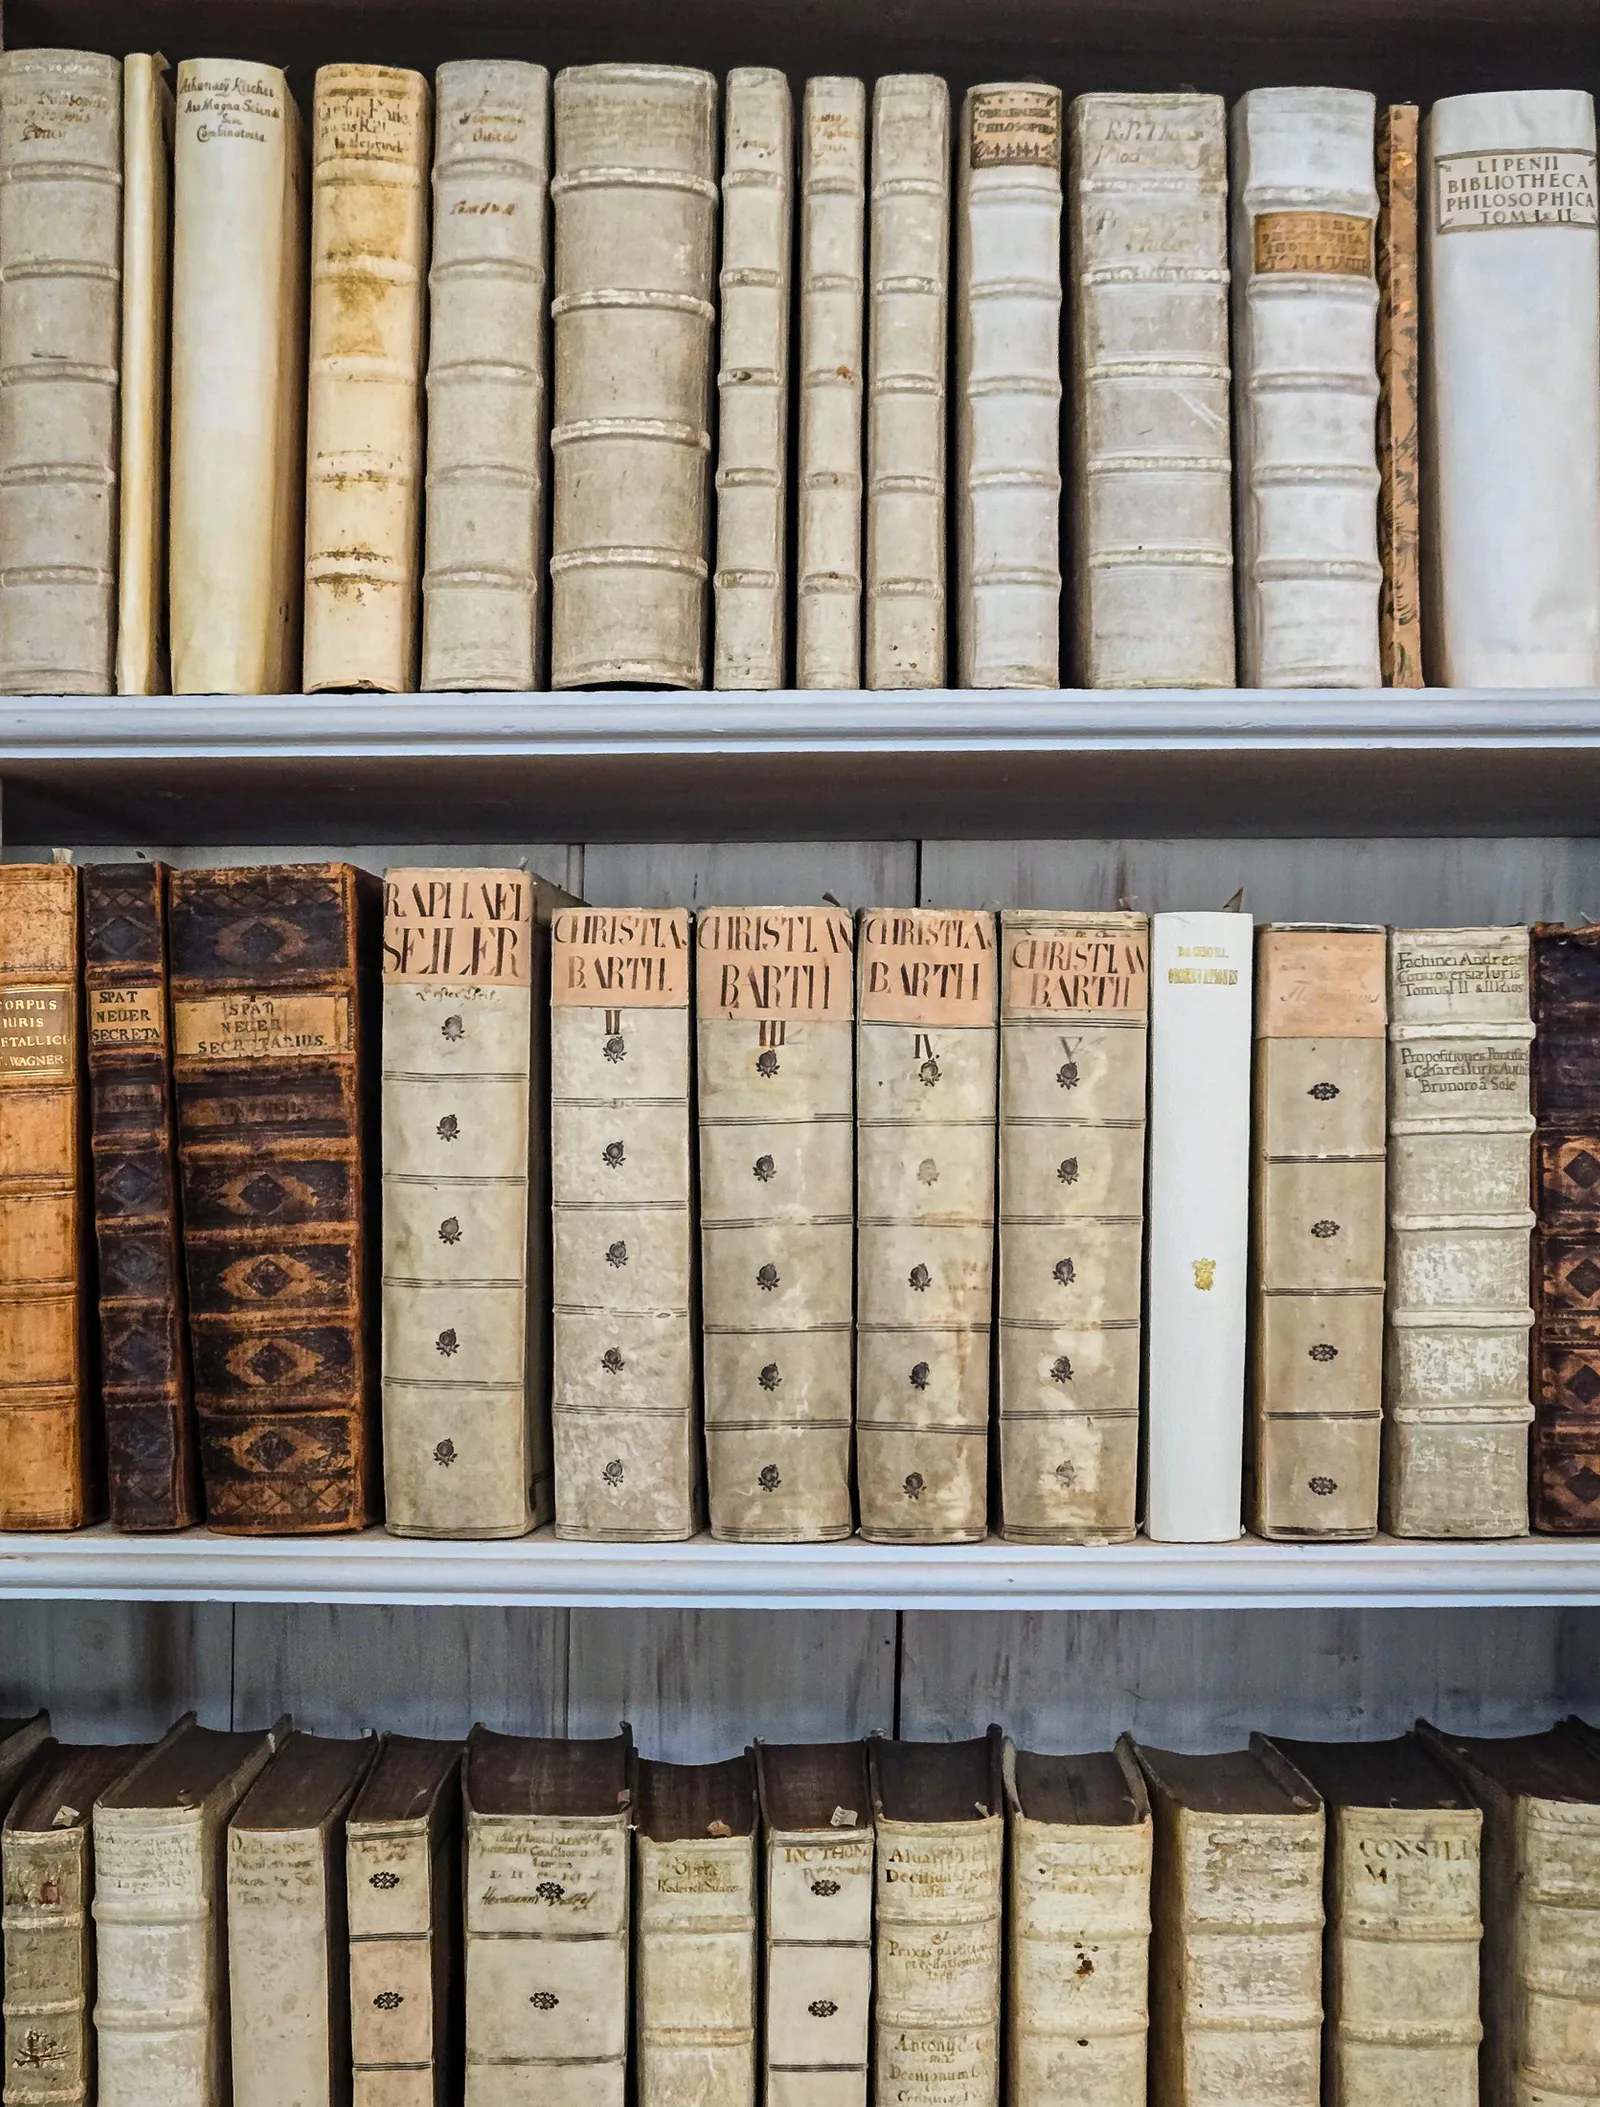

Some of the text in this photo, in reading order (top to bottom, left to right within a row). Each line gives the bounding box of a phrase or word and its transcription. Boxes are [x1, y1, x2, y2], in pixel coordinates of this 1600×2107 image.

[1477, 156, 1559, 173] LIPENII
[1447, 173, 1589, 194] BIBLIOTHECA
[1446, 192, 1596, 213] PHILOSOPHICA
[0, 999, 57, 1011] ORPUS
